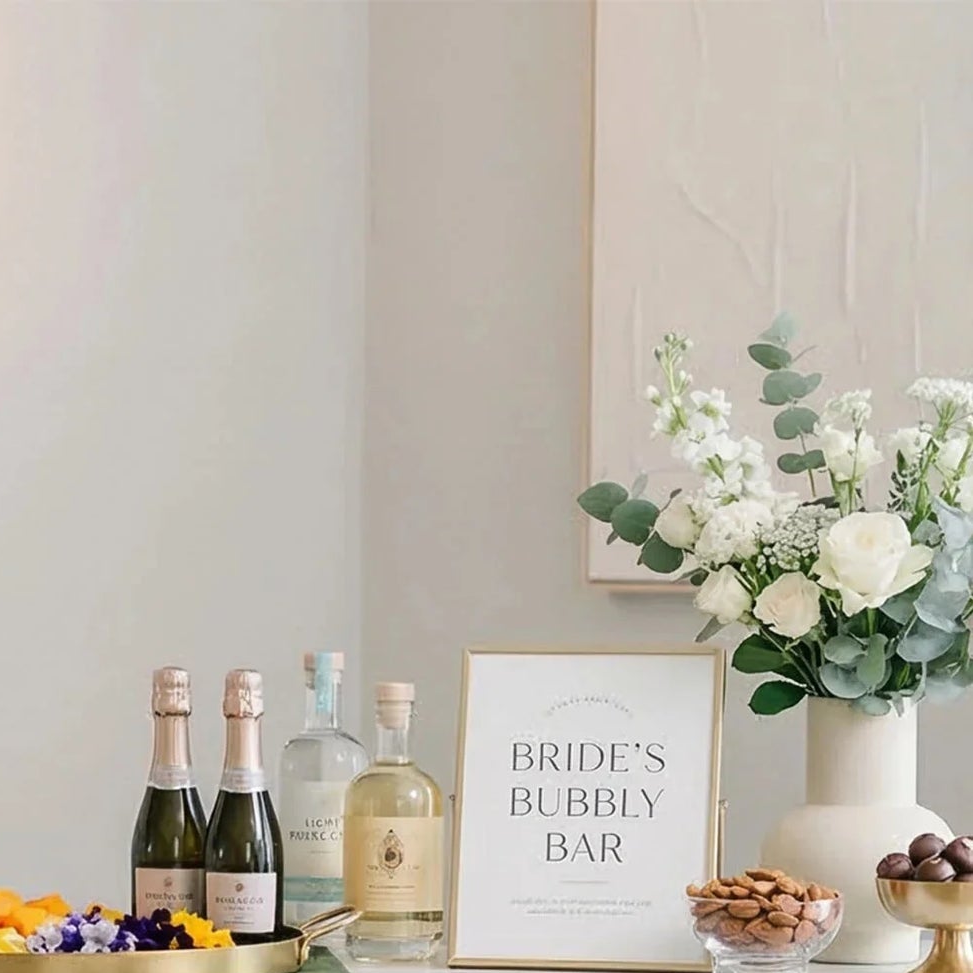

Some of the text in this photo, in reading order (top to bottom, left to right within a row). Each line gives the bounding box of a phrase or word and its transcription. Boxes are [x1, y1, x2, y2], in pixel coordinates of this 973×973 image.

[512, 742, 666, 773] BRIDE'S
[510, 787, 664, 819] BUBBLY
[545, 832, 623, 863] BAR
